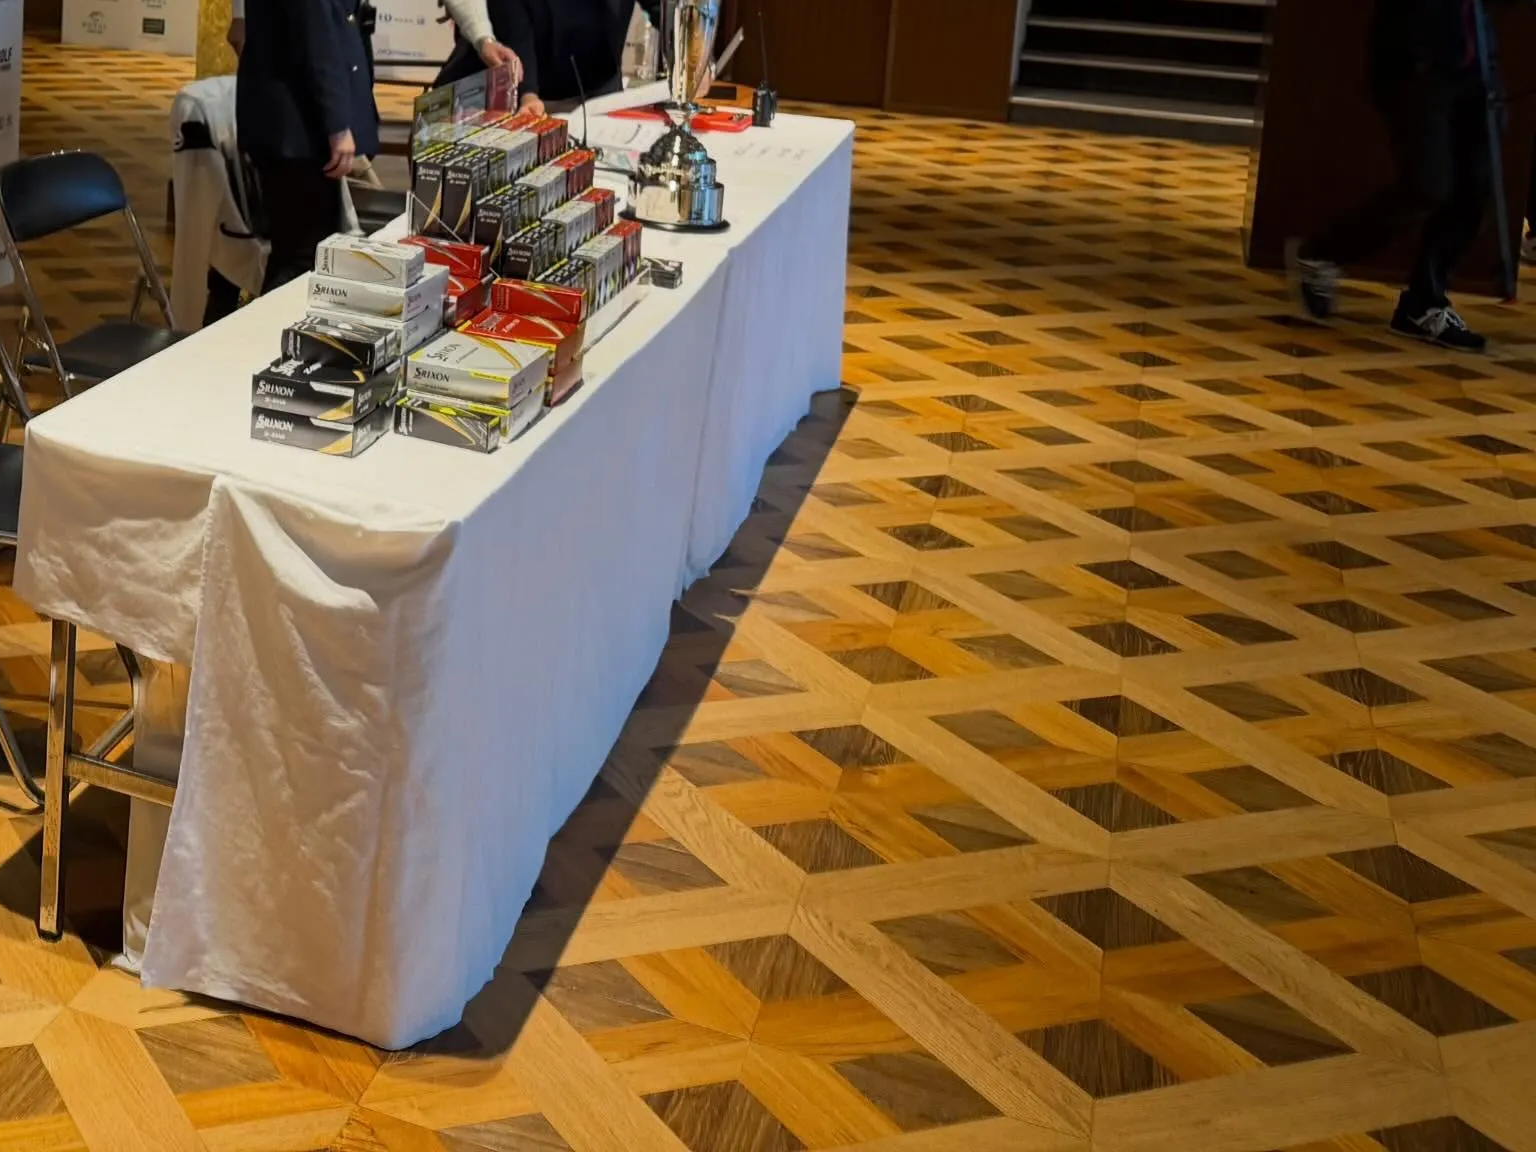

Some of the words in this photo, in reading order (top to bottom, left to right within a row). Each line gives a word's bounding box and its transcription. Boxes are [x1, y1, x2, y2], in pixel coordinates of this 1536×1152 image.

[313, 283, 348, 298] SRIXON
[413, 366, 450, 383] SRIXON
[256, 379, 295, 397] SRIXON
[255, 414, 294, 432] SRIXON
